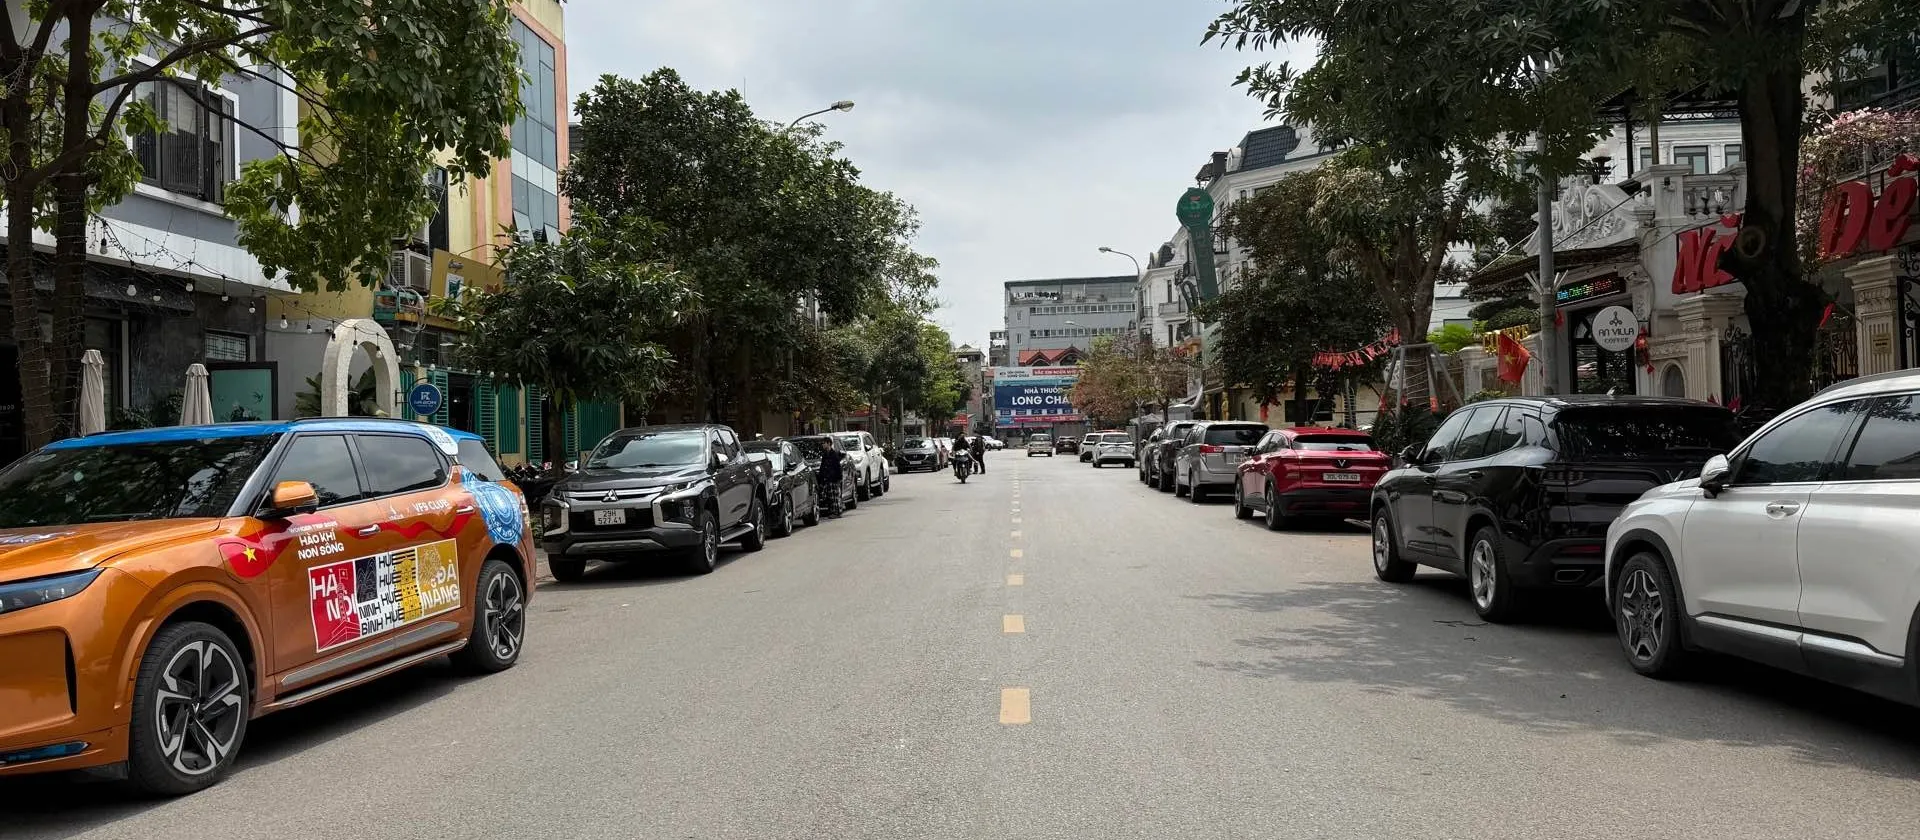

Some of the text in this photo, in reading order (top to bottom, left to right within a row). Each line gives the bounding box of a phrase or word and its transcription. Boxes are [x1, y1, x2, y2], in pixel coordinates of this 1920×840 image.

[1598, 326, 1635, 337] AN VILLA
[1024, 386, 1038, 394] NHÀ
[1012, 396, 1042, 405] LONG
[412, 499, 450, 512] VF9 CLUB
[299, 527, 336, 546] HÀO KHÍ
[298, 541, 345, 560] NON SÔNG
[436, 559, 457, 584] ĐÀ
[312, 568, 338, 600] HÀ
[358, 602, 381, 619] NINH
[361, 617, 384, 636] BÌNH
